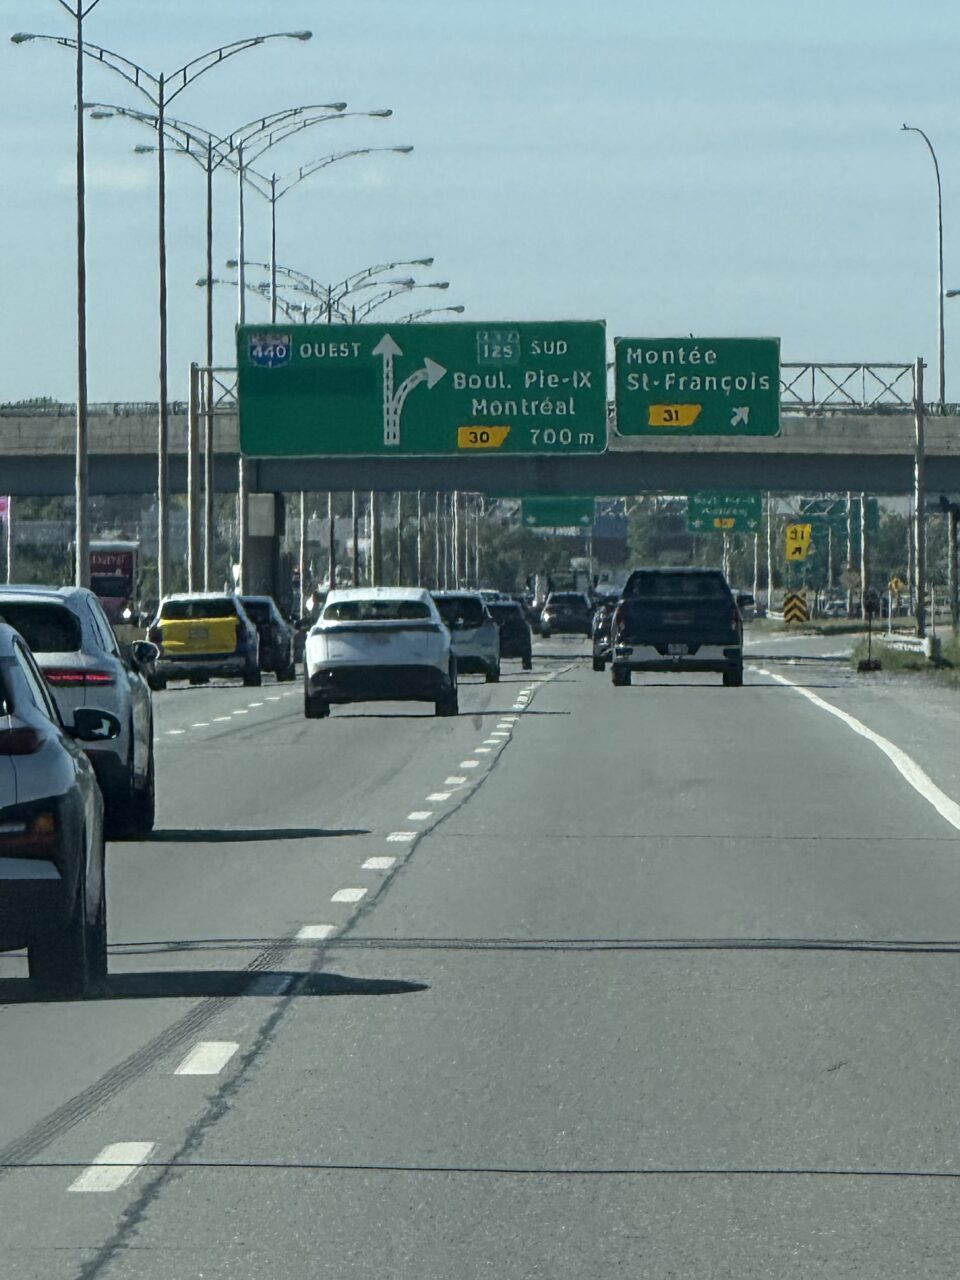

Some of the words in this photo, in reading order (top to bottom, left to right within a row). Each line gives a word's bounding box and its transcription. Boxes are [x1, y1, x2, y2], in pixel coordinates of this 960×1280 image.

[253, 345, 286, 358] 440
[300, 343, 361, 358] OUEST
[484, 344, 513, 358] 125
[530, 340, 568, 355] SUD
[626, 346, 717, 365] Montée
[453, 371, 511, 389] Boul.
[525, 370, 592, 389] Pie-IX
[627, 371, 770, 396] St-François
[471, 397, 575, 416] Montréal
[663, 409, 679, 422] 31
[469, 431, 490, 444] 30
[530, 428, 572, 445] 700
[579, 432, 594, 444] m
